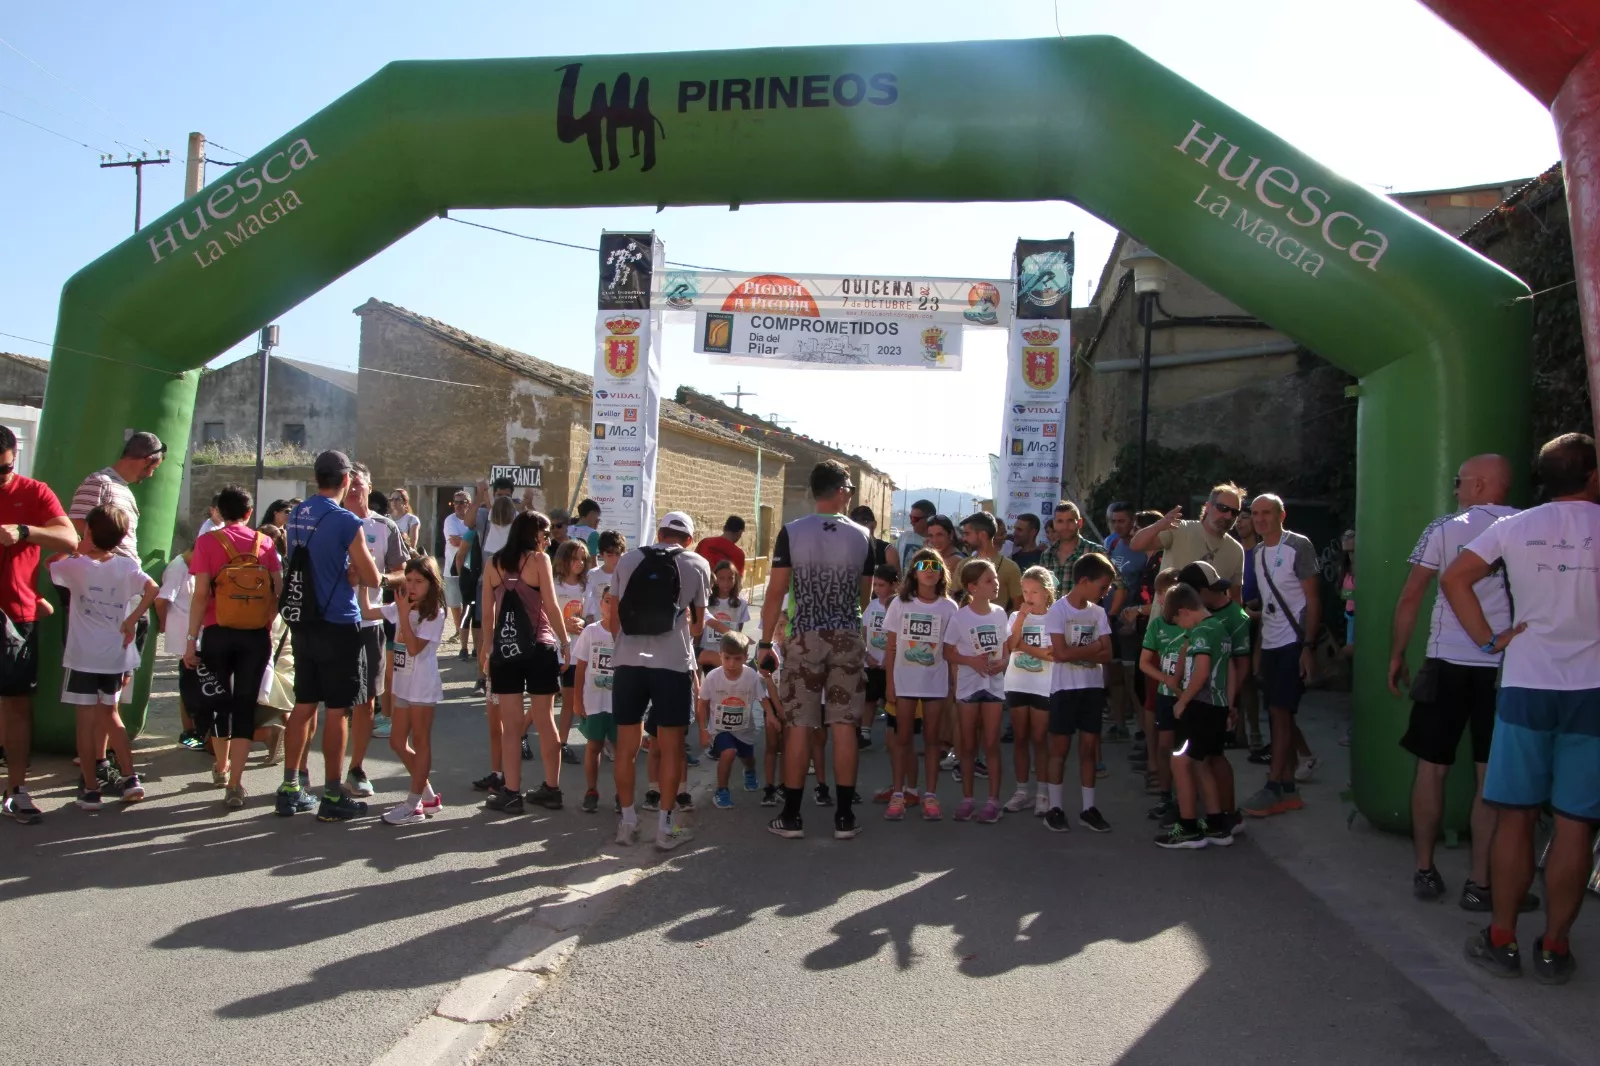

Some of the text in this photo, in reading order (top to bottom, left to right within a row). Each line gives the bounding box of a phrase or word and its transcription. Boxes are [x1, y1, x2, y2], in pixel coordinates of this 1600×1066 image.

[678, 72, 899, 113] PIRINEOS
[146, 137, 319, 264] Huesca
[1173, 119, 1389, 272] Huesca
[842, 278, 913, 297] QUICENA
[842, 297, 913, 310] 7 de OCTUBRE
[918, 295, 940, 312] 23
[751, 315, 899, 336] COMPROMETIDOS
[766, 333, 780, 343] del
[749, 342, 779, 355] Pilar
[877, 345, 902, 356] 2023
[610, 392, 641, 400] VIDAL
[281, 605, 301, 621] ca
[910, 622, 931, 634] 483
[980, 633, 996, 645] 457
[500, 643, 522, 658] ca
[599, 656, 612, 668] 42
[723, 714, 743, 724] 420
